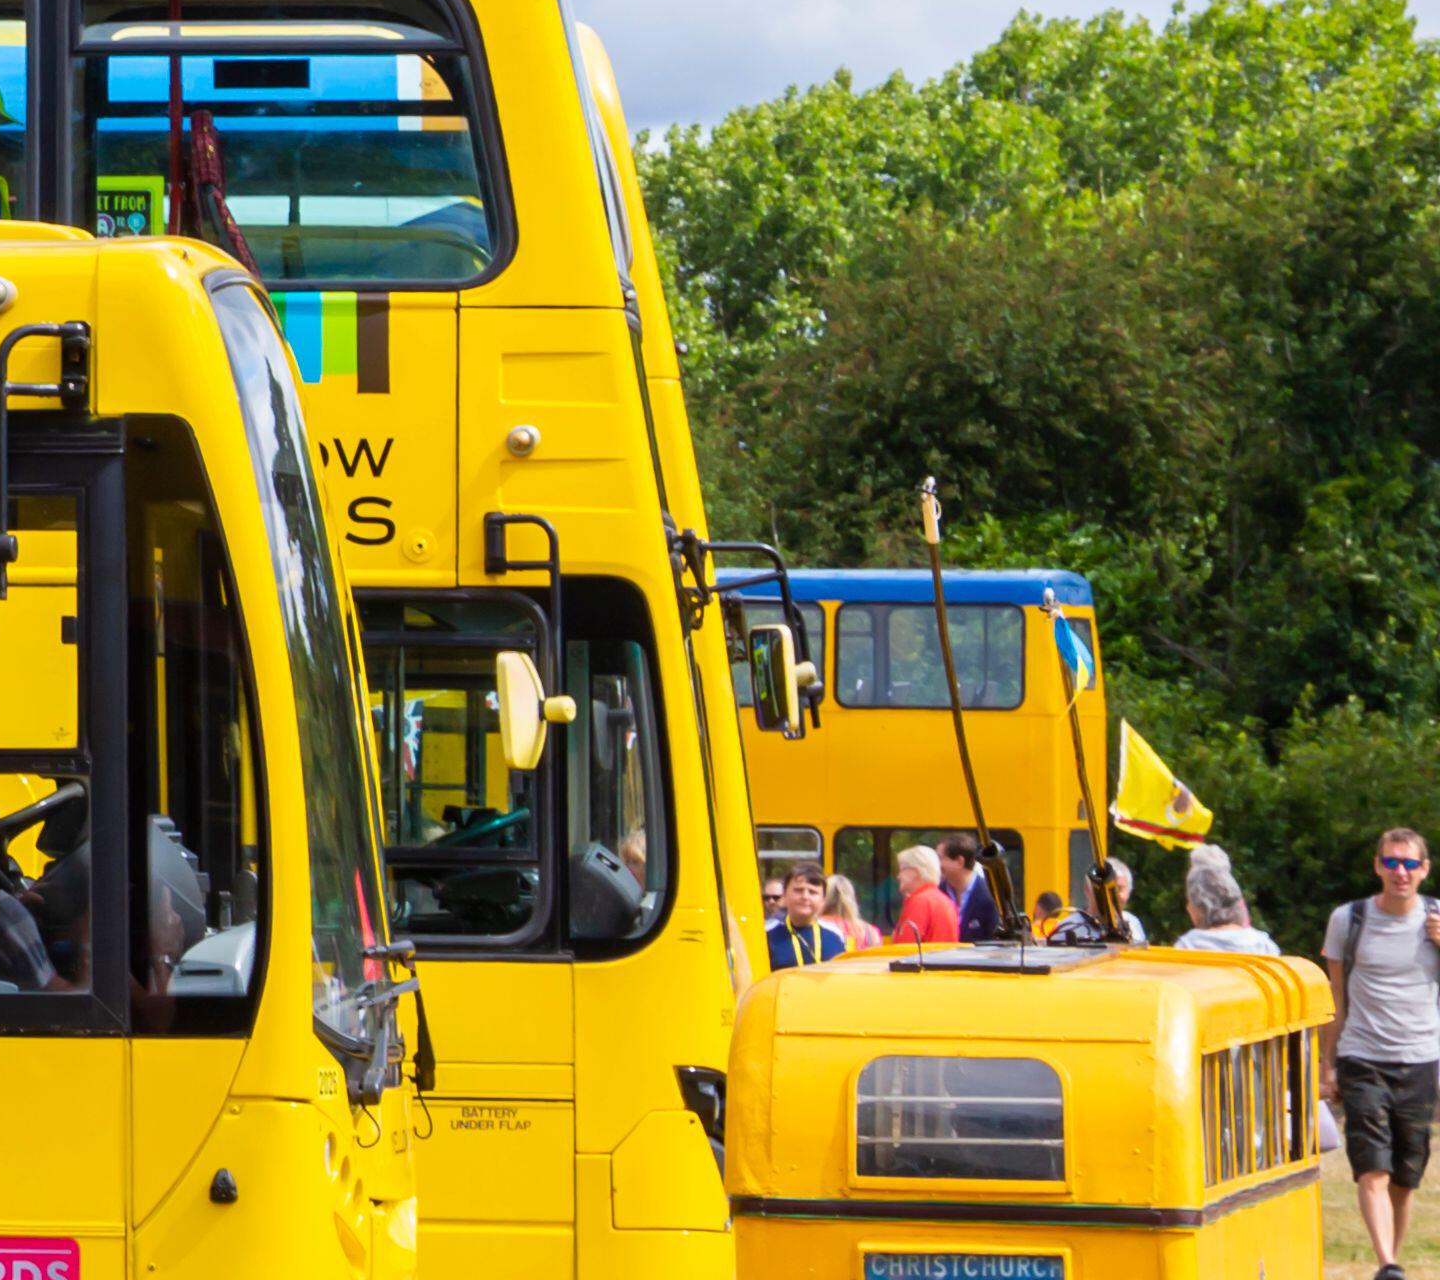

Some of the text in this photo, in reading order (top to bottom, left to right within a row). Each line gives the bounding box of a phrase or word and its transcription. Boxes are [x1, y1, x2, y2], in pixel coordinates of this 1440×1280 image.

[114, 195, 146, 211] FROM
[318, 437, 395, 478] W
[461, 1106, 518, 1118] BATTERY
[450, 1119, 532, 1131] UNDER FLAP
[871, 1254, 1063, 1279] CHRISTCHURCH
